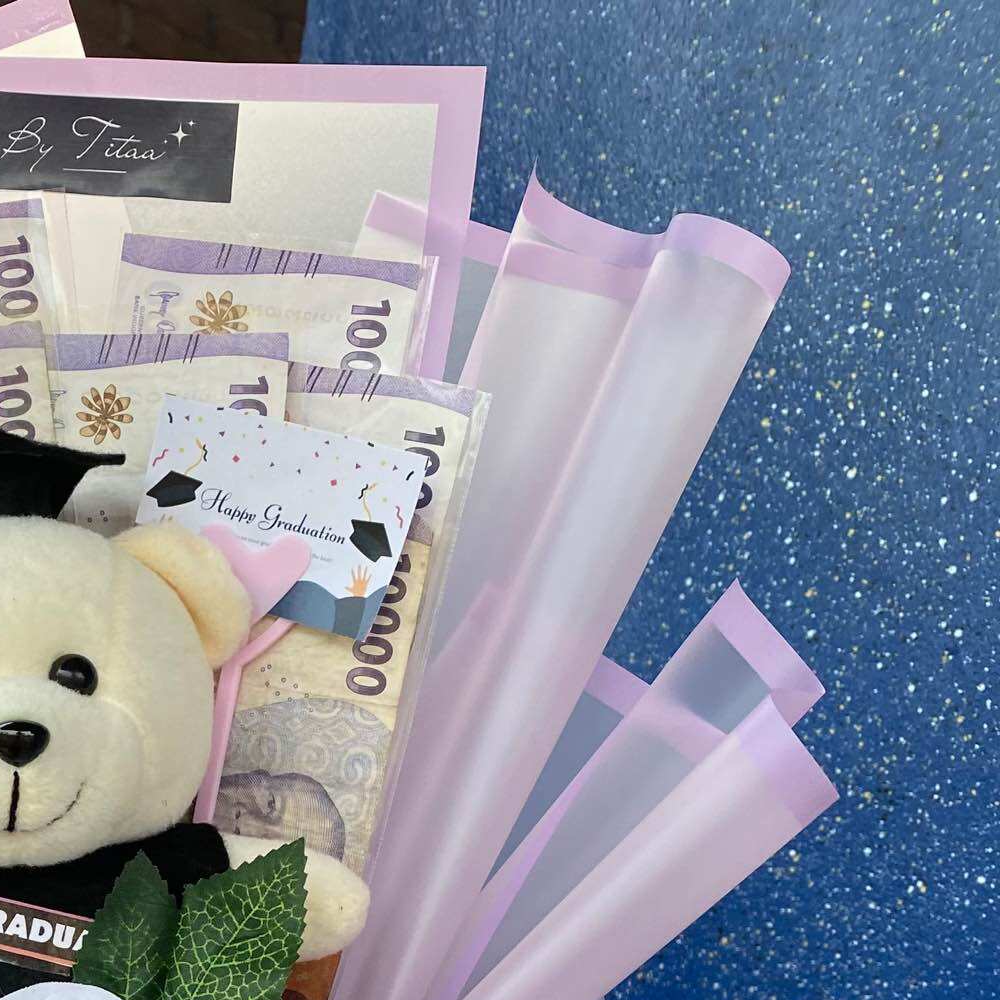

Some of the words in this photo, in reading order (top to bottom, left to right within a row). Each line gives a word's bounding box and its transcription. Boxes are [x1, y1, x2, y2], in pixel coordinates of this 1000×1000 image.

[0, 116, 53, 173] By
[200, 488, 256, 524] Happy
[257, 504, 346, 545] Graduation
